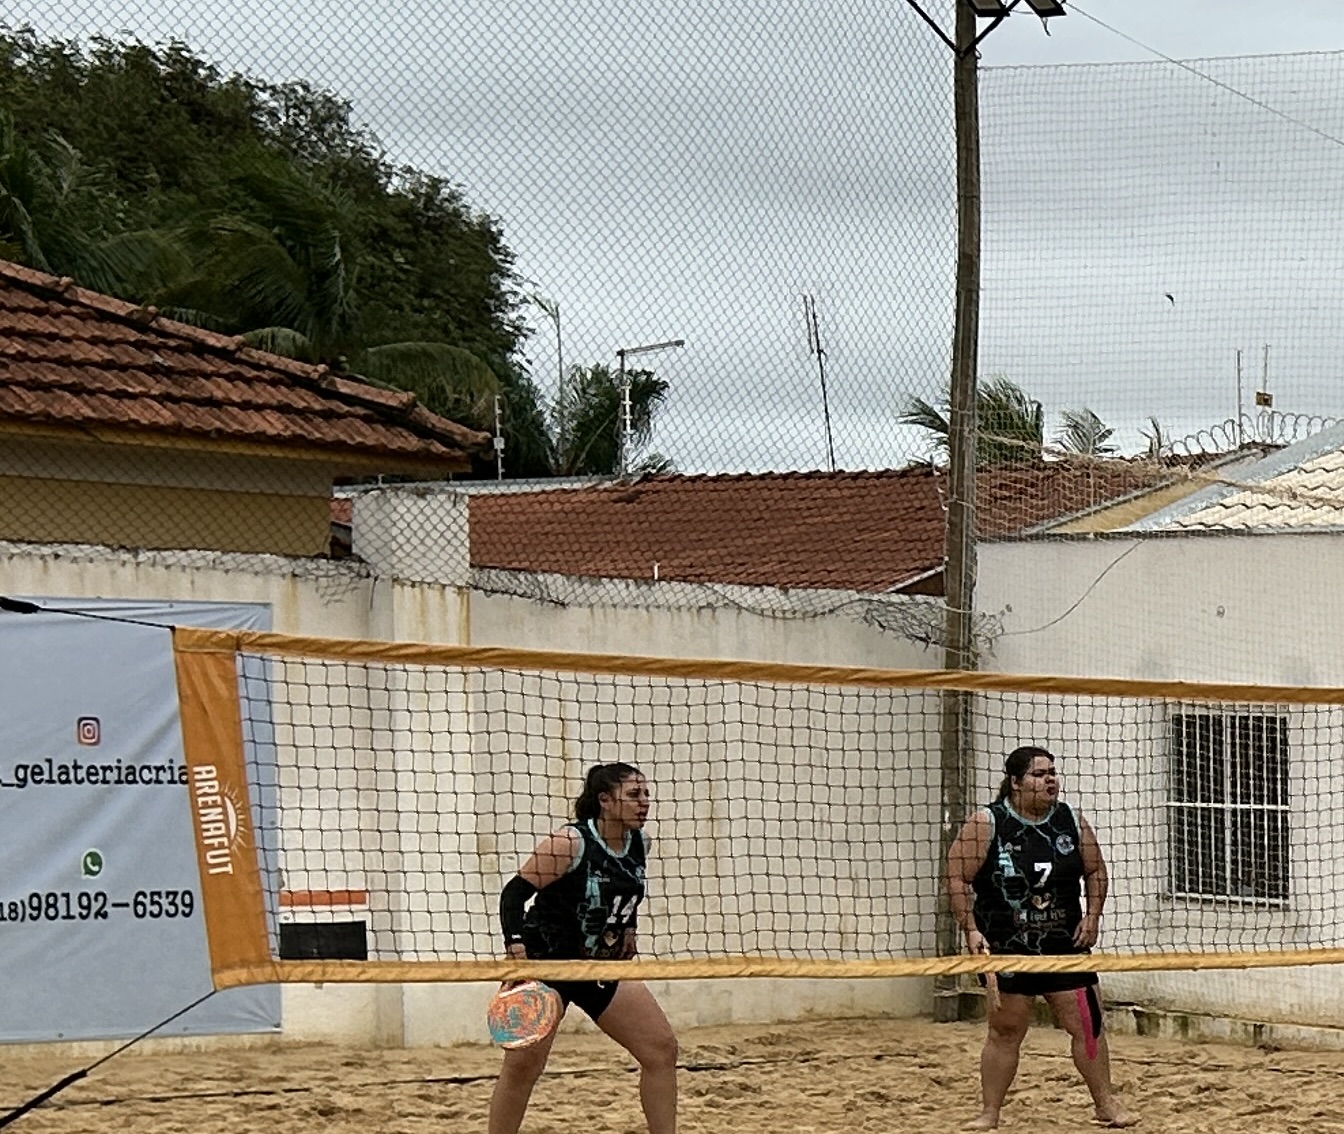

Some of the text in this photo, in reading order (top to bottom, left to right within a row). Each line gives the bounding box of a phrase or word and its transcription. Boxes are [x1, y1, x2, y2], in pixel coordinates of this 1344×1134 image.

[0, 758, 188, 789] _gelateriacria
[192, 765, 233, 875] ARENAFUT
[1033, 861, 1053, 888] 7
[606, 895, 638, 924] 14
